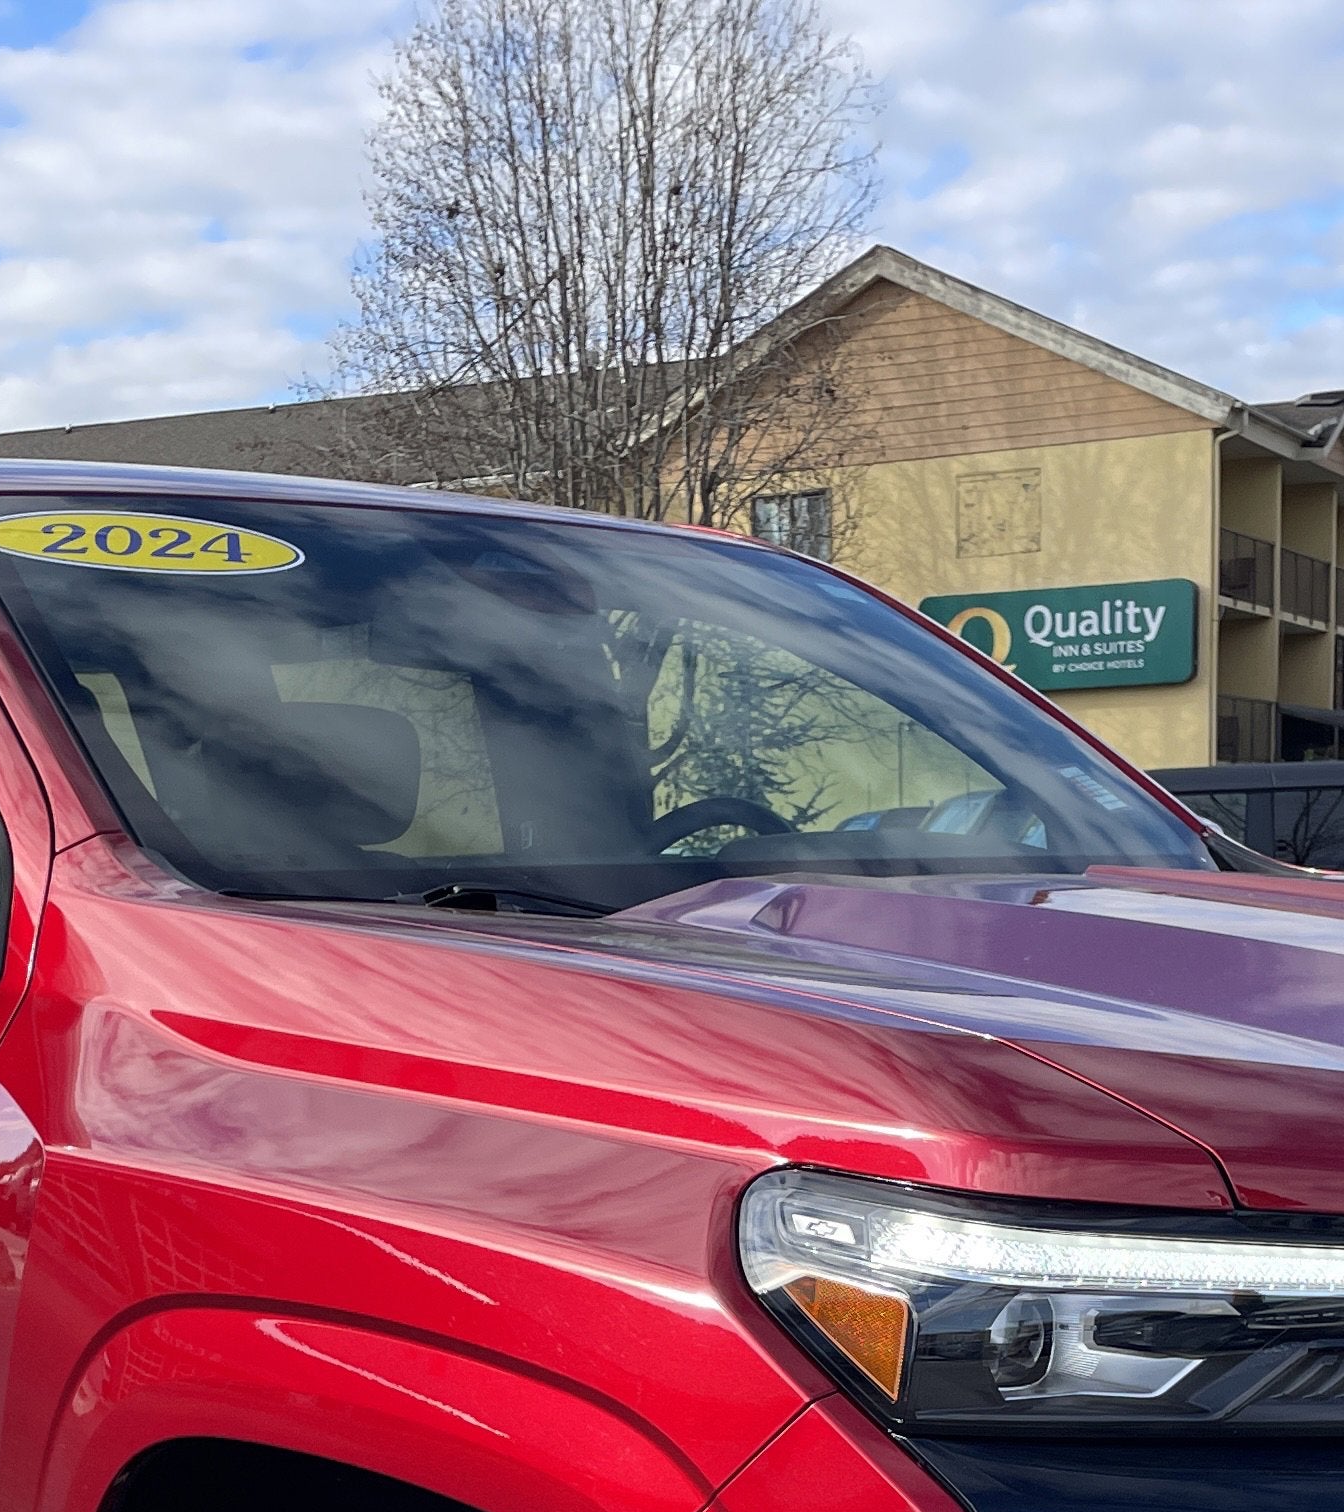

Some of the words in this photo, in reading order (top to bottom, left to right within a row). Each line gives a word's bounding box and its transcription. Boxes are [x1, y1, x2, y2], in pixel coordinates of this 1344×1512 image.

[41, 523, 253, 564] 2024
[1023, 599, 1167, 647] Quality
[1053, 643, 1080, 657] INN
[1081, 642, 1092, 656] &
[1093, 639, 1145, 655] SUITES
[1052, 662, 1067, 673] BY
[1067, 660, 1105, 673] CHOICE
[1106, 658, 1145, 670] HOTELS
